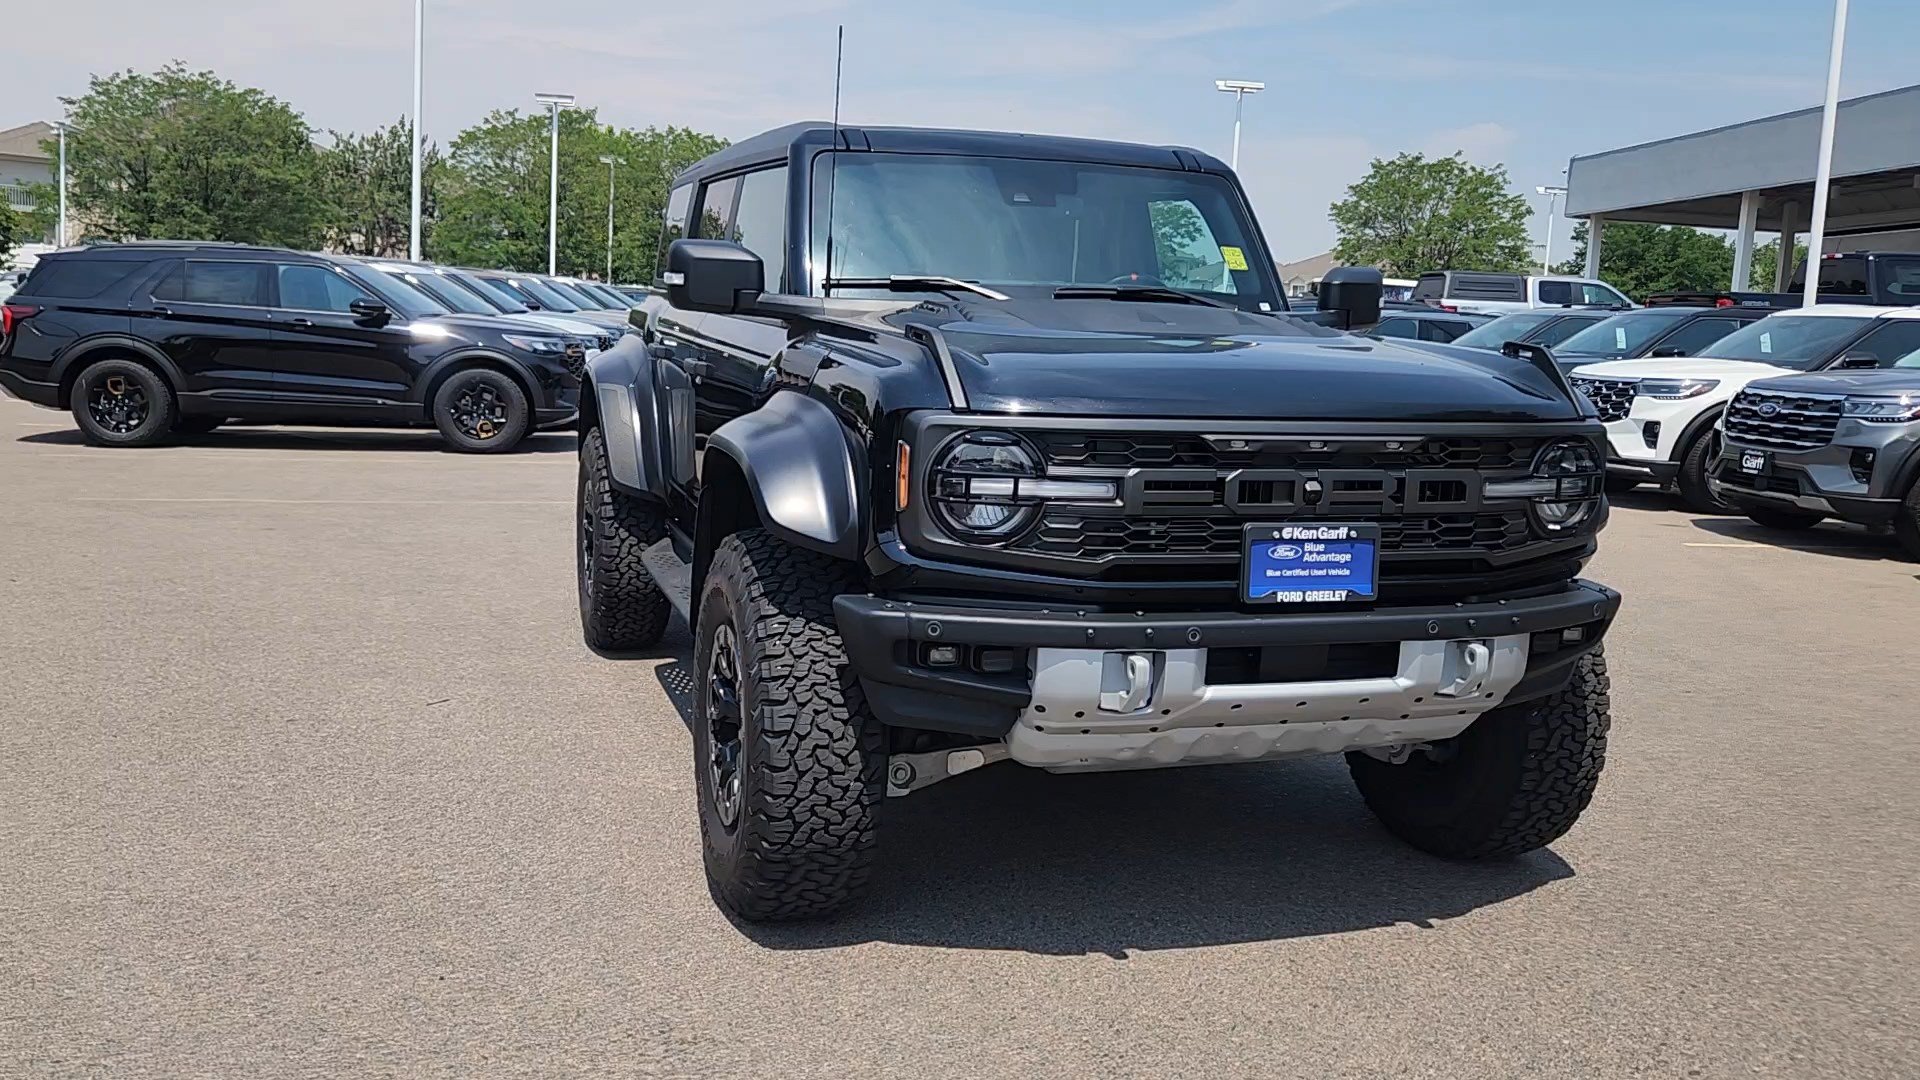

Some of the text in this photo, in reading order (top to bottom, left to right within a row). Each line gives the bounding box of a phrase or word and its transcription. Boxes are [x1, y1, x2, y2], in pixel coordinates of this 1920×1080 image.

[1742, 455, 1764, 469] Garff
[1124, 468, 1481, 516] FORD
[1304, 542, 1325, 551] Blue
[1303, 552, 1351, 563] Advantage
[1266, 568, 1350, 577] Blue Certified Used Vehicle
[1277, 590, 1348, 602] FORD GREELEY
